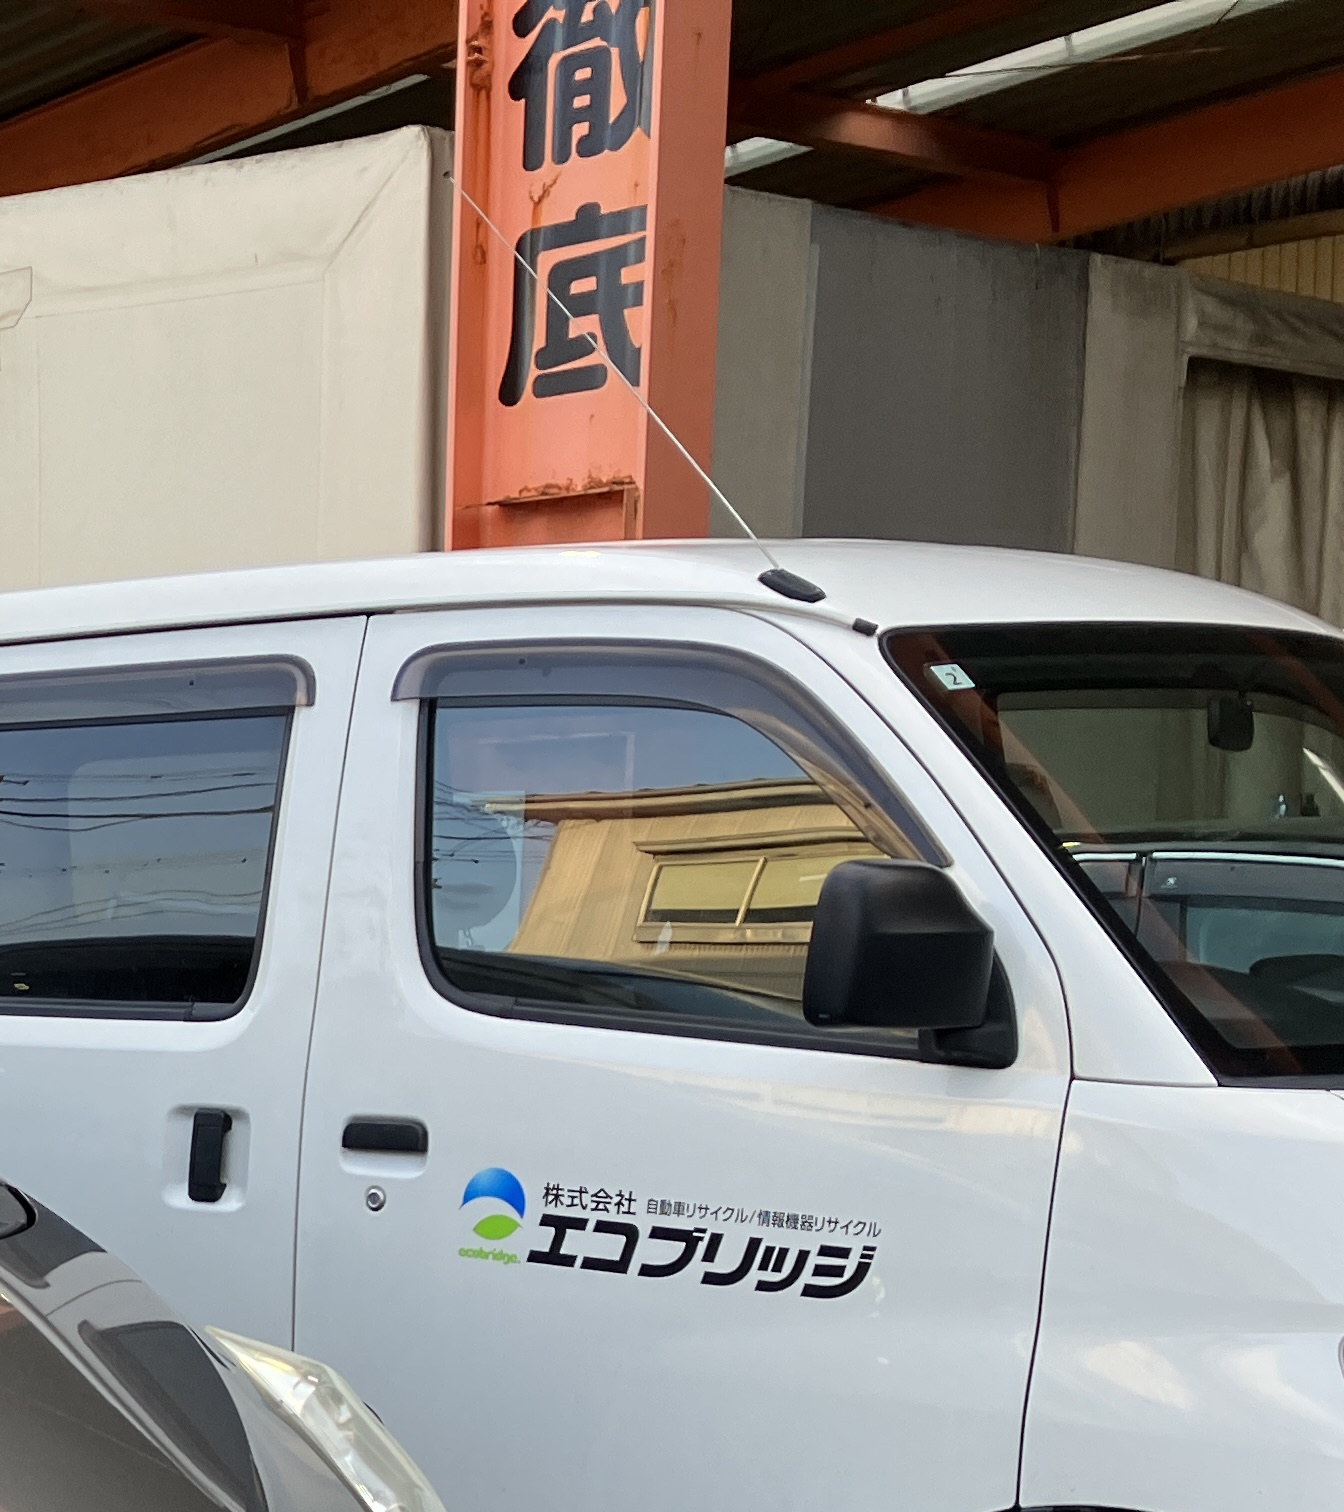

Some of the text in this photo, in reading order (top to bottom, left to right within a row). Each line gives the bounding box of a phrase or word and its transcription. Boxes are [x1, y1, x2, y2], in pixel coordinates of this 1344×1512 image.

[542, 1181, 637, 1217] 株式会社
[526, 1213, 878, 1300] エコブリッジ
